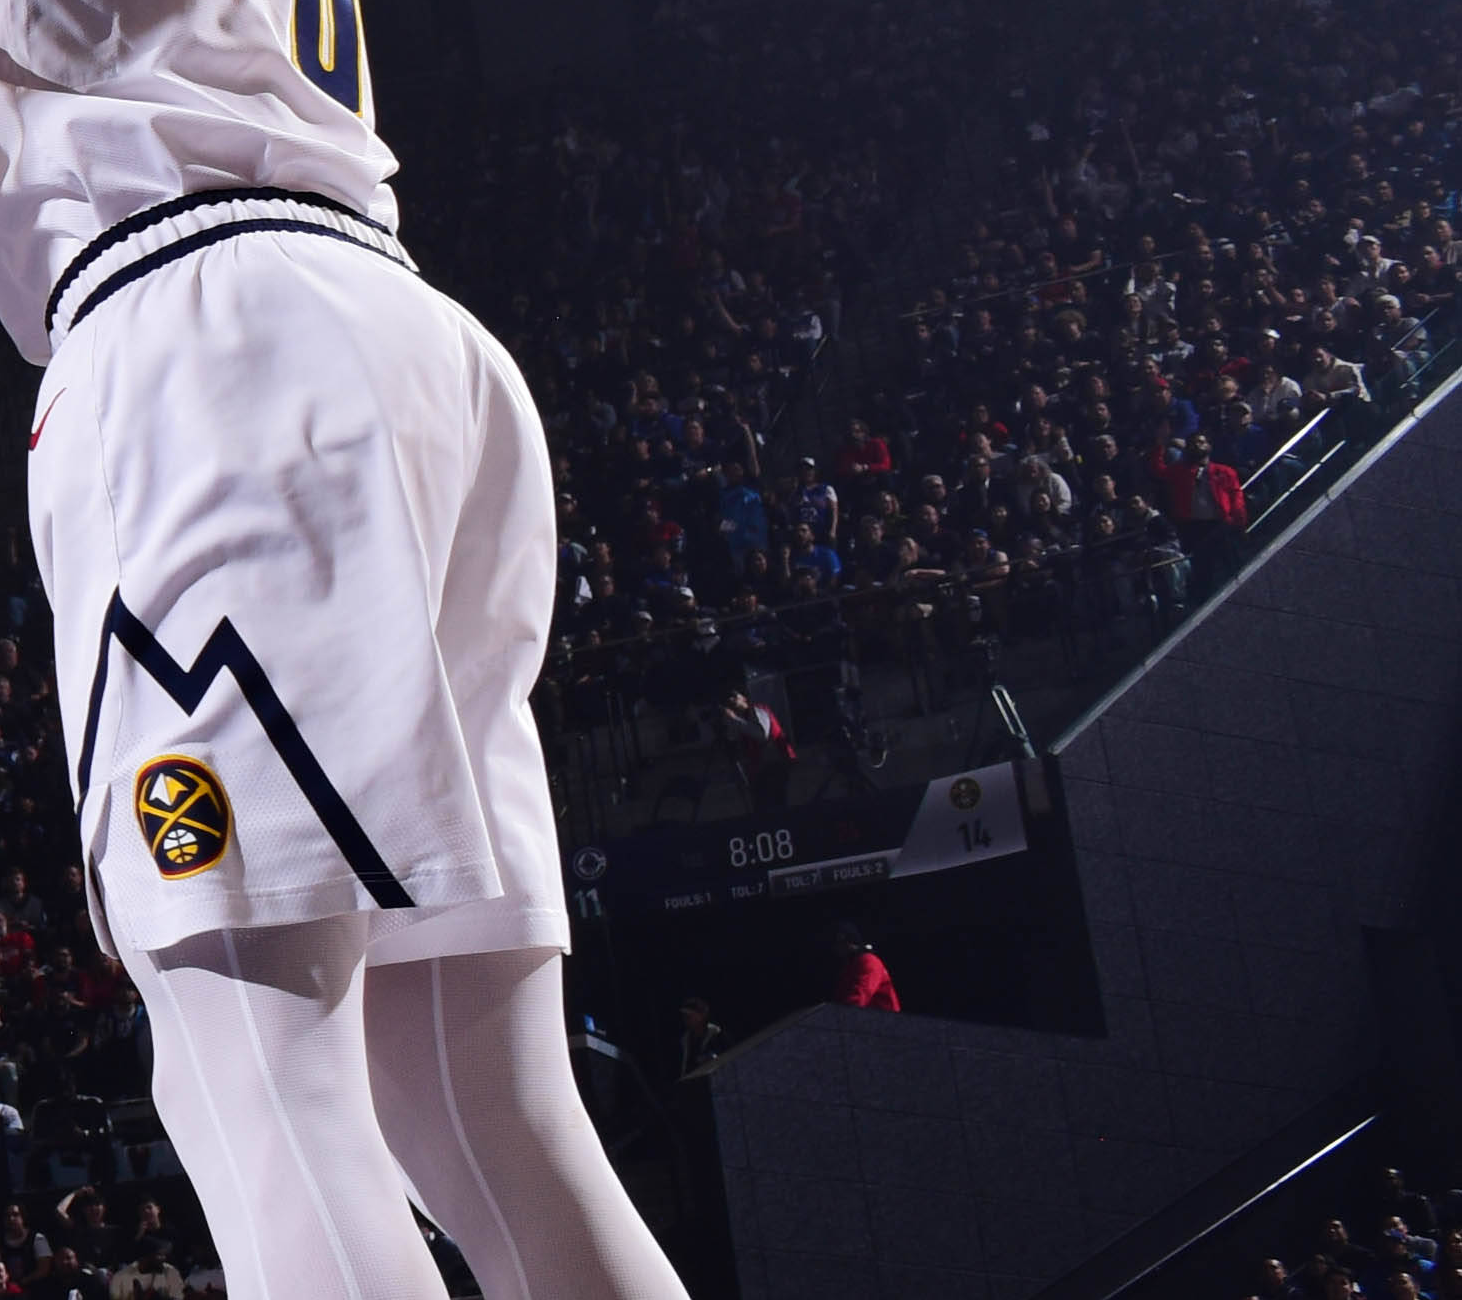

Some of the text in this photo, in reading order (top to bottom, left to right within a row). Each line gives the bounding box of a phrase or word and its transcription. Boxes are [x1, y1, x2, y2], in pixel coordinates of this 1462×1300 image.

[729, 829, 795, 868] 8:08
[956, 818, 993, 853] 14
[574, 887, 601, 919] 11
